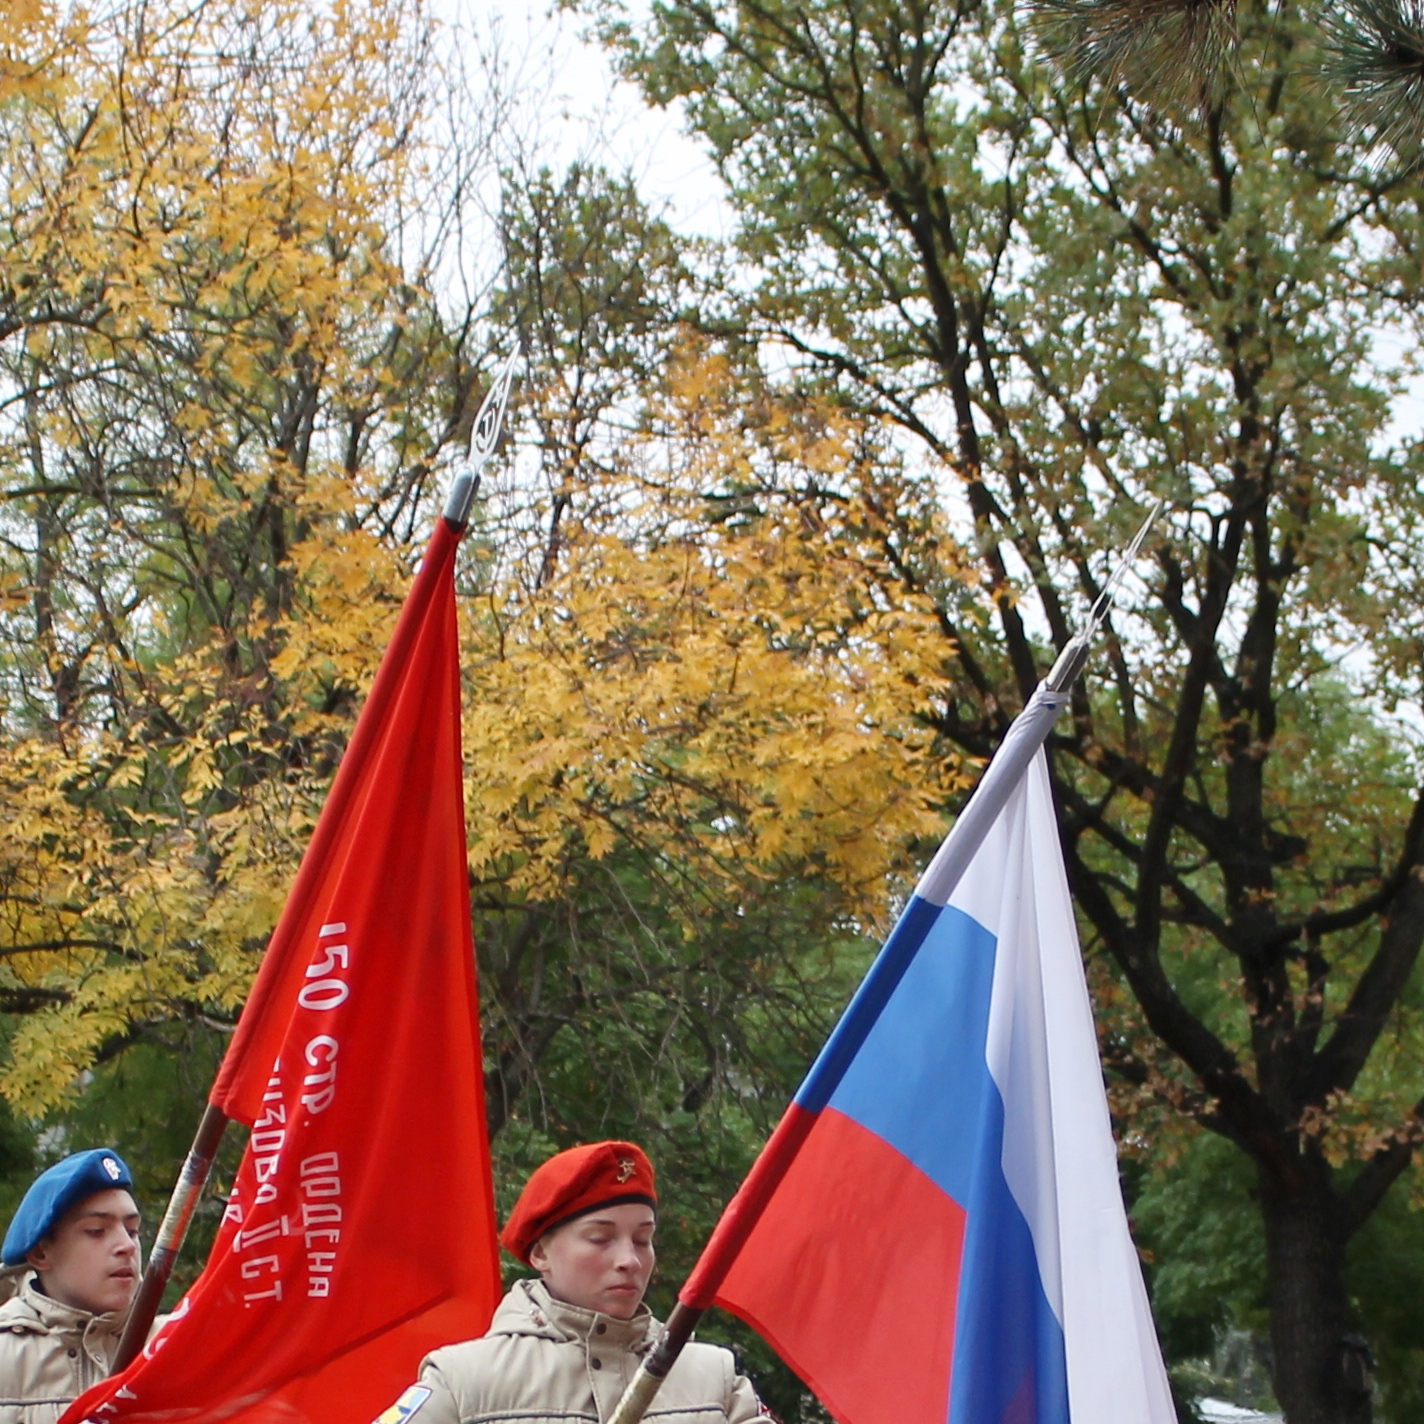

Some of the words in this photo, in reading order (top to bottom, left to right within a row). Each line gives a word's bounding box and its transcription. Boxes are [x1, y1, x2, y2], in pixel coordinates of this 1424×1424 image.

[298, 922, 349, 1010] 150
[301, 1034, 339, 1127] СТР.
[300, 1152, 342, 1297] ОРДЕНА
